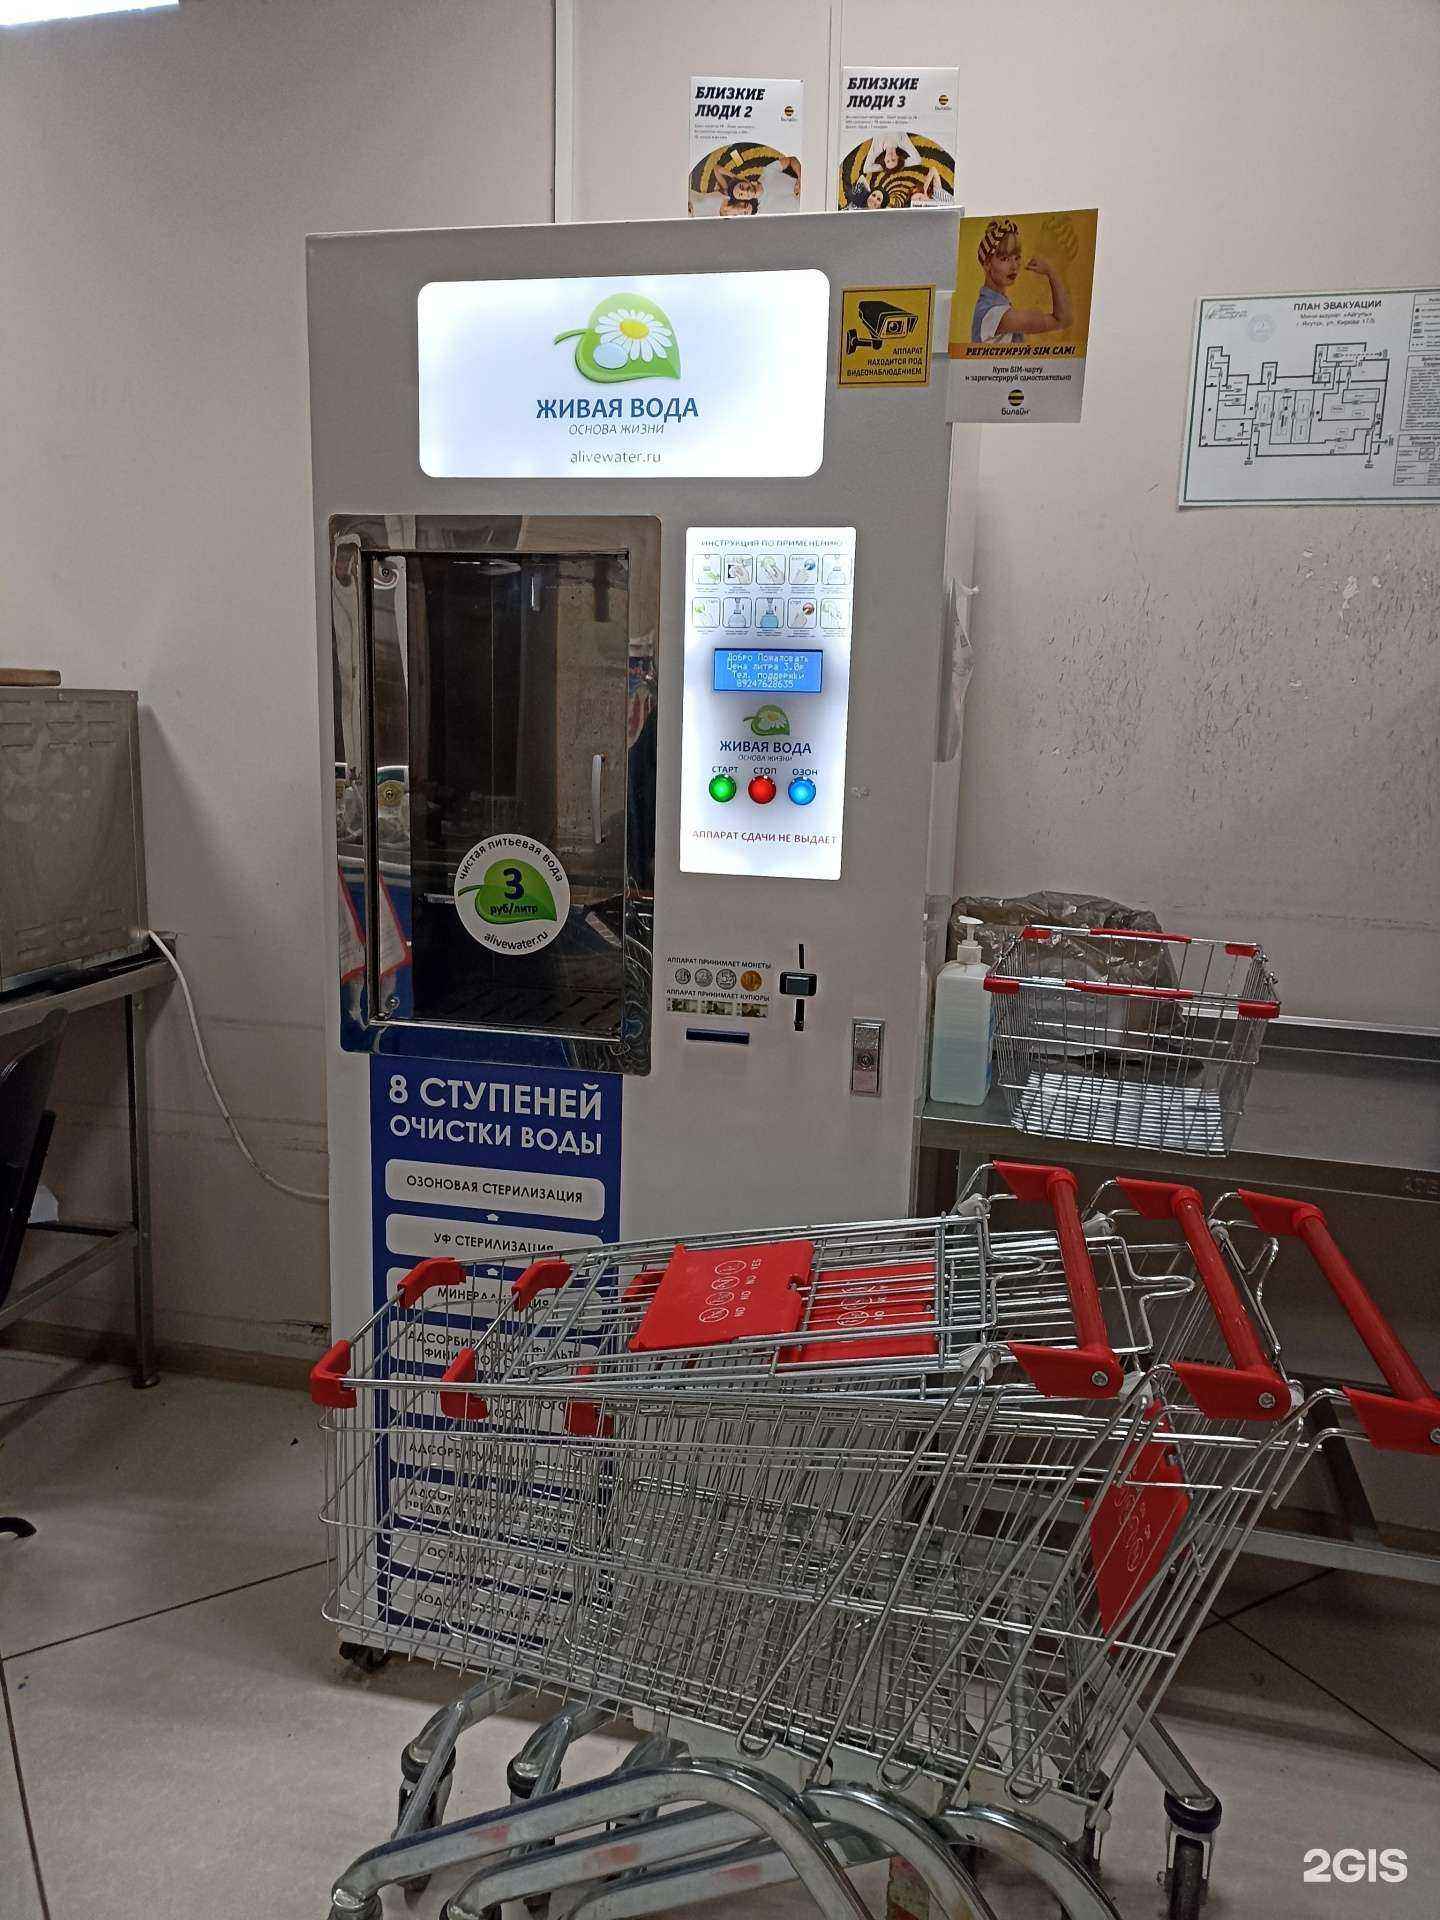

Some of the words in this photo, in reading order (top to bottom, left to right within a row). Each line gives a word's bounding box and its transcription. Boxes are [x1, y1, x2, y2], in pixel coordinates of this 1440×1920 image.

[847, 77, 919, 91] БЛИЗКИЕ
[695, 86, 766, 101] БЛИЗКИЕ
[846, 95, 892, 110] ЛЮДИ
[897, 95, 906, 108] 3
[695, 104, 741, 120] ЛЮДИ
[744, 106, 753, 118] 2
[1293, 303, 1320, 311] ПЛАН
[1323, 300, 1382, 310] ЭВАКУАЦИИ
[893, 347, 923, 355] АППАРАТ
[966, 345, 1030, 356] РЕГИСТРИРУЙ
[1033, 347, 1050, 355] SIM
[1052, 346, 1076, 355] САМ!
[867, 358, 907, 366] НАХОДИТСЯ
[907, 357, 923, 365] ПОД
[847, 368, 922, 377] ВИДЕОНАБЛЮДЕНИЕМ
[536, 398, 623, 419] ЖИВАЯ
[630, 397, 699, 422] ВОДА
[568, 423, 617, 436] ОСНОВА
[620, 423, 665, 435] ЖИЗНИ
[570, 449, 662, 465] alivewater.ru
[720, 740, 769, 753] ЖИВАЯ
[774, 742, 812, 756] ВОДА
[712, 766, 739, 774] СТАРТ
[753, 767, 777, 775] СТОП
[792, 768, 818, 776] ОЗОН
[692, 830, 738, 839] АППАРАТ
[741, 832, 776, 843] СДАЧИ
[778, 834, 791, 842] НЕ
[459, 845, 486, 880] чистая
[488, 838, 542, 855] питьевая
[542, 853, 563, 882] вода
[503, 867, 525, 900] 3
[490, 903, 538, 916] руб/литр
[484, 931, 548, 950] alivewater.ru
[698, 959, 740, 967] ПРИНИМАЕТ
[741, 961, 771, 969] МОНЕТЫ
[698, 991, 739, 999] ПРИНИМАЕТ
[389, 1074, 408, 1104] 8
[419, 1077, 602, 1121] СТУПЕНЕЙ
[390, 1115, 511, 1147] ОЧИСТКИ
[521, 1127, 602, 1156] ВОДЫ
[406, 1175, 478, 1193] ОЗОНОВАЯ
[482, 1183, 583, 1203] СТЕРИЛИЗАЦИЯ
[433, 1233, 451, 1244] УФ
[455, 1235, 554, 1253] СТЕРИЛИЗАЦИЯ
